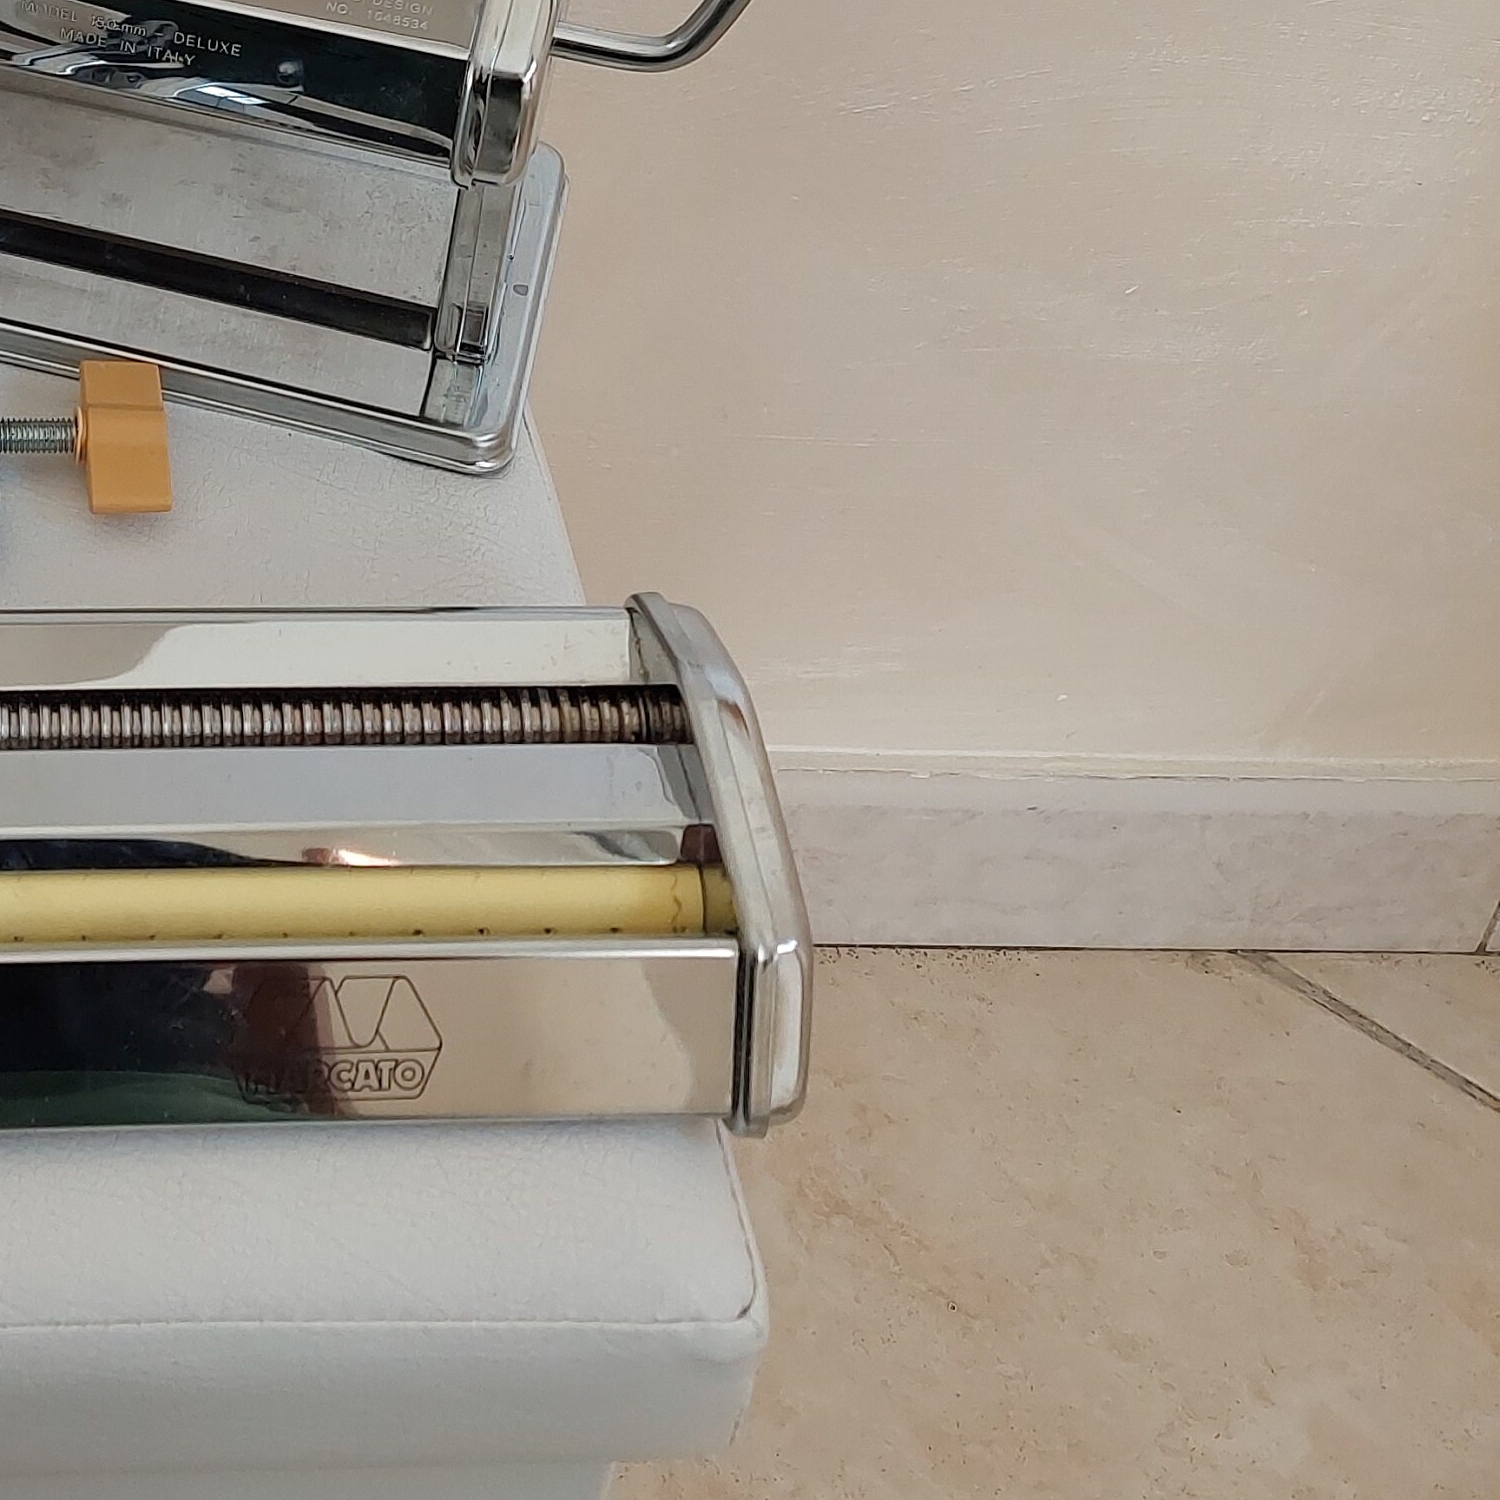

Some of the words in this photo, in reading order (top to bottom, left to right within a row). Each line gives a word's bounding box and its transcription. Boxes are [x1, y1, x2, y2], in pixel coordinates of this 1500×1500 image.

[60, 27, 107, 48] MADE
[119, 39, 137, 55] IN
[147, 45, 196, 67] ITALY
[173, 30, 243, 57] DELUXE
